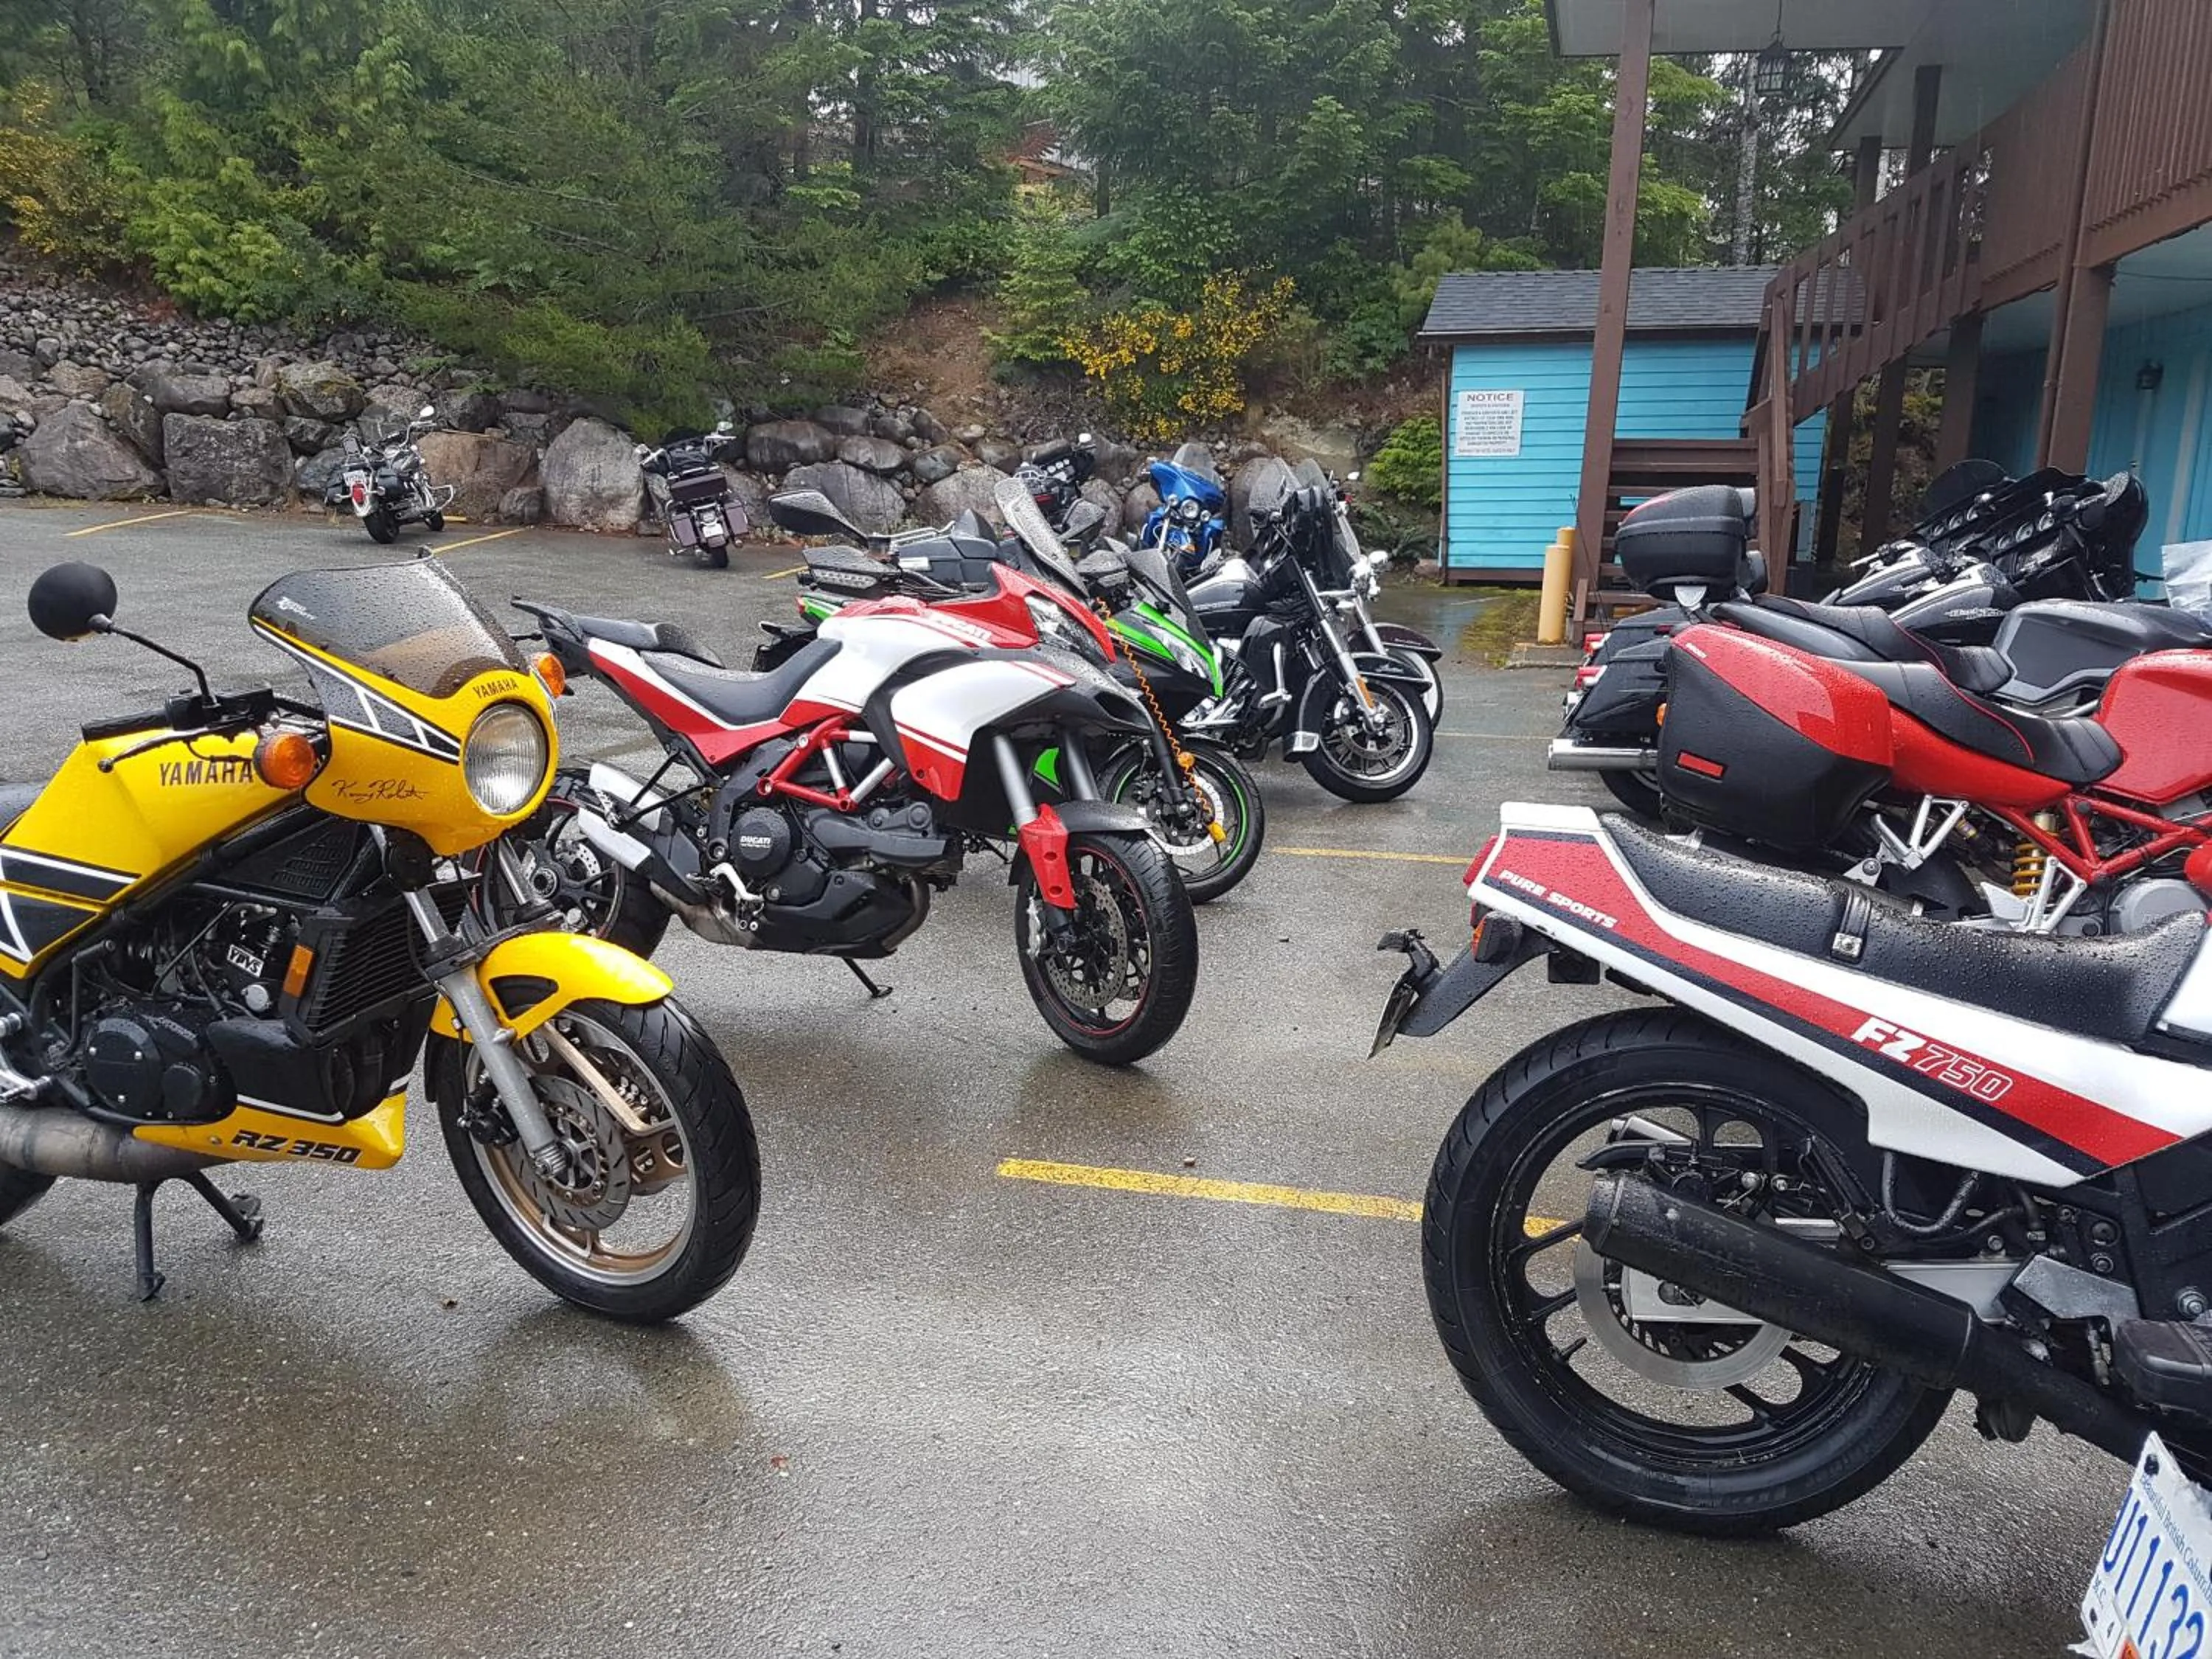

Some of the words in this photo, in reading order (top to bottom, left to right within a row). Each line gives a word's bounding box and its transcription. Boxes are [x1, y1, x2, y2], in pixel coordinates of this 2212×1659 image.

[1467, 393, 1514, 402] NOTICE
[473, 678, 519, 699] YAMAHA
[159, 759, 254, 787] YAMAHA
[740, 835, 771, 844] DUCATI
[1498, 869, 1548, 897] PURE
[1546, 891, 1618, 929] SPORTS
[230, 948, 261, 974] YPVS
[231, 1129, 289, 1152] RZ
[287, 1138, 364, 1166] 350
[2163, 1511, 2186, 1556] British
[2183, 1545, 2212, 1606] Columb
